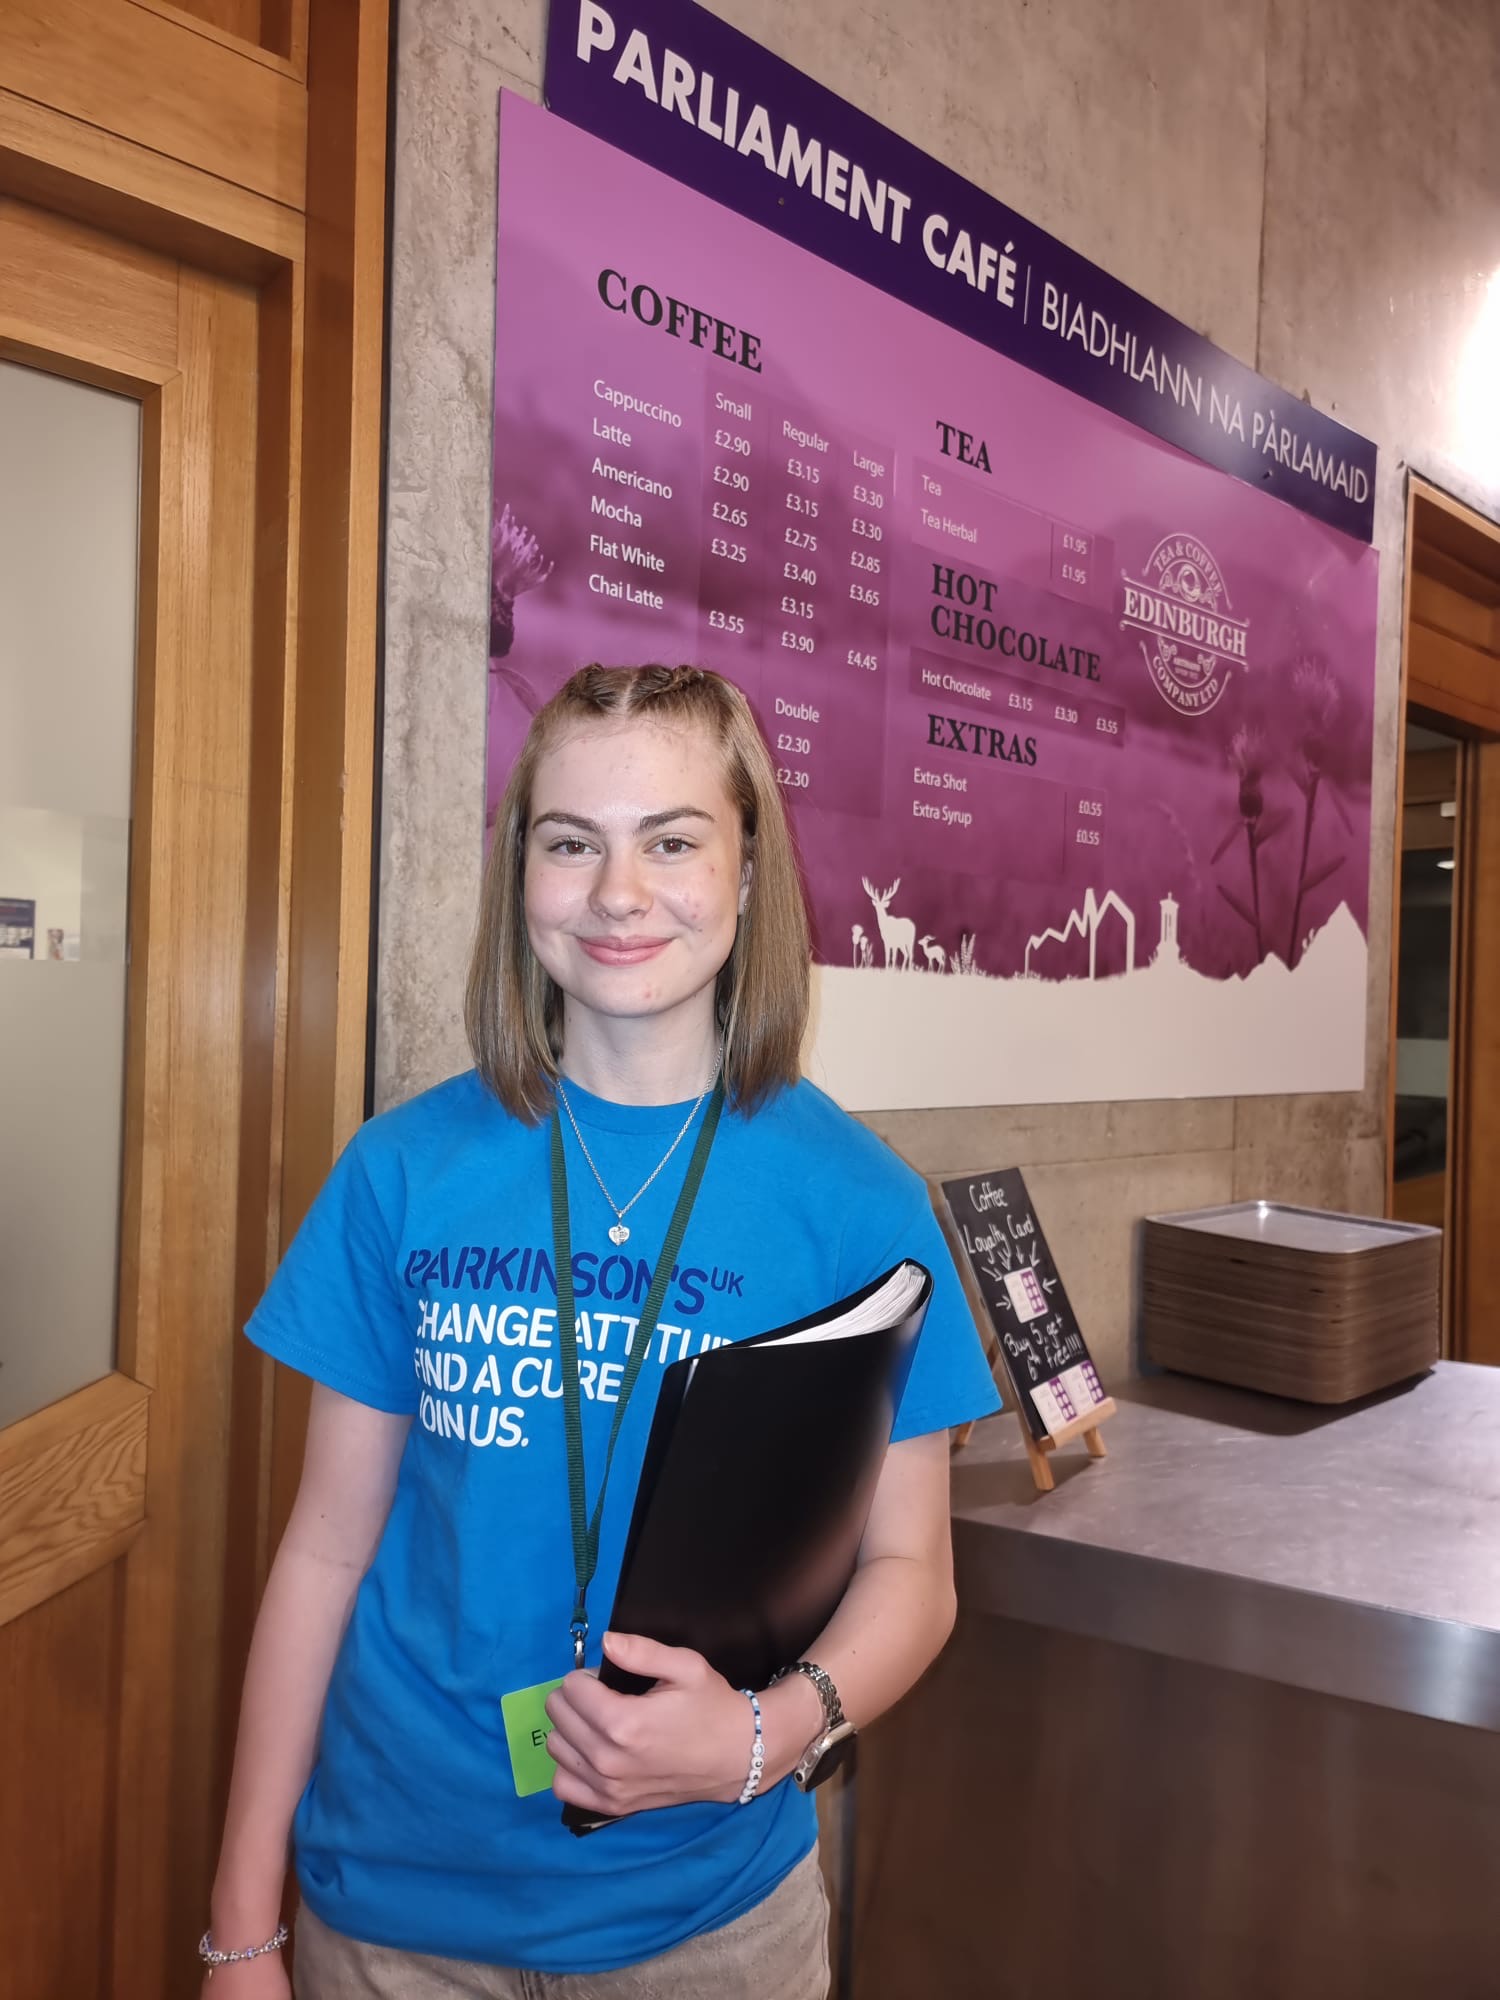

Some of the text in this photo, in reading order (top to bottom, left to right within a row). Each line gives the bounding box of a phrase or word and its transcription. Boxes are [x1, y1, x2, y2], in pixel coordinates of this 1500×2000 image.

[577, 0, 1017, 308] PARLIAMENT CAFÉ
[597, 268, 763, 374] COFFEE
[1042, 282, 1368, 503] BIADHLANN NA PÀRLAMAID
[593, 379, 883, 509] Cappuccino £2.90 £3.15 £3.30
[715, 392, 885, 478] Small Regular Large
[936, 419, 993, 474] TEA
[593, 417, 882, 541] Latte £2.90 £3.15 £3.30
[921, 474, 942, 497] Tea
[591, 456, 881, 574] Americano £2.65 £2.75 £2.85
[920, 508, 978, 543] Tea Herbal
[591, 495, 880, 606] Mocha £3.25 £3.40 £3.65
[1063, 534, 1088, 555] £1.95
[1153, 545, 1177, 573] TEA
[590, 534, 814, 620] Flat White £3.15
[931, 563, 998, 612] HOT
[1061, 564, 1087, 585] £1.95
[589, 574, 877, 671] Chai Latte £3.55 £3.90 £4.45
[931, 604, 1101, 682] CHOCOLATE
[1123, 586, 1247, 657] EDINBURGH
[775, 697, 820, 723] Double
[922, 668, 1118, 735] Hot Chocolate £3.15 £3.30 £3.55
[777, 733, 810, 755] £2.30
[927, 713, 1038, 767] EXTRAS
[776, 768, 809, 788] £2.30
[914, 767, 1102, 817] Extra Shot £0.55
[913, 800, 1100, 846] Extra Syrup £0.55
[968, 1181, 1008, 1212] Coffee
[963, 1213, 1035, 1264] Loyalty Card
[403, 1246, 744, 1315] PARKINSON'S UK
[575, 1311, 733, 1364] ATTTU
[1004, 1332, 1036, 1361] Buy
[472, 1354, 501, 1396] A
[512, 1357, 625, 1402] CURE
[469, 1404, 529, 1447] US.
